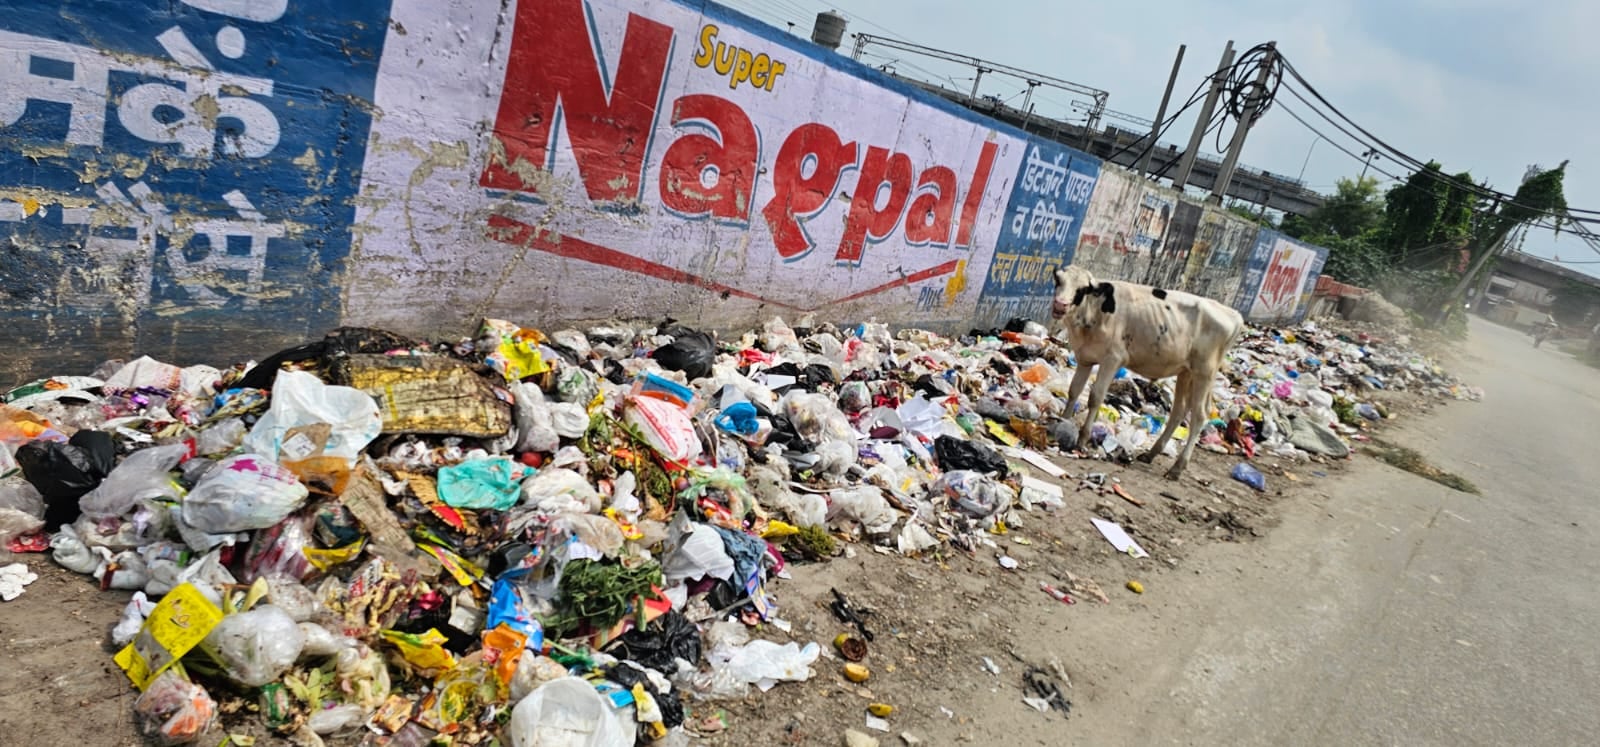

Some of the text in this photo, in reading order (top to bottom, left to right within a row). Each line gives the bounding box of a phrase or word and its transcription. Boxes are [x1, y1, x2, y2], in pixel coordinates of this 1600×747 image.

[694, 24, 787, 91] Super
[479, 0, 999, 268] Nagpal
[1065, 170, 1096, 206] पाउडर
[1011, 205, 1030, 239] व
